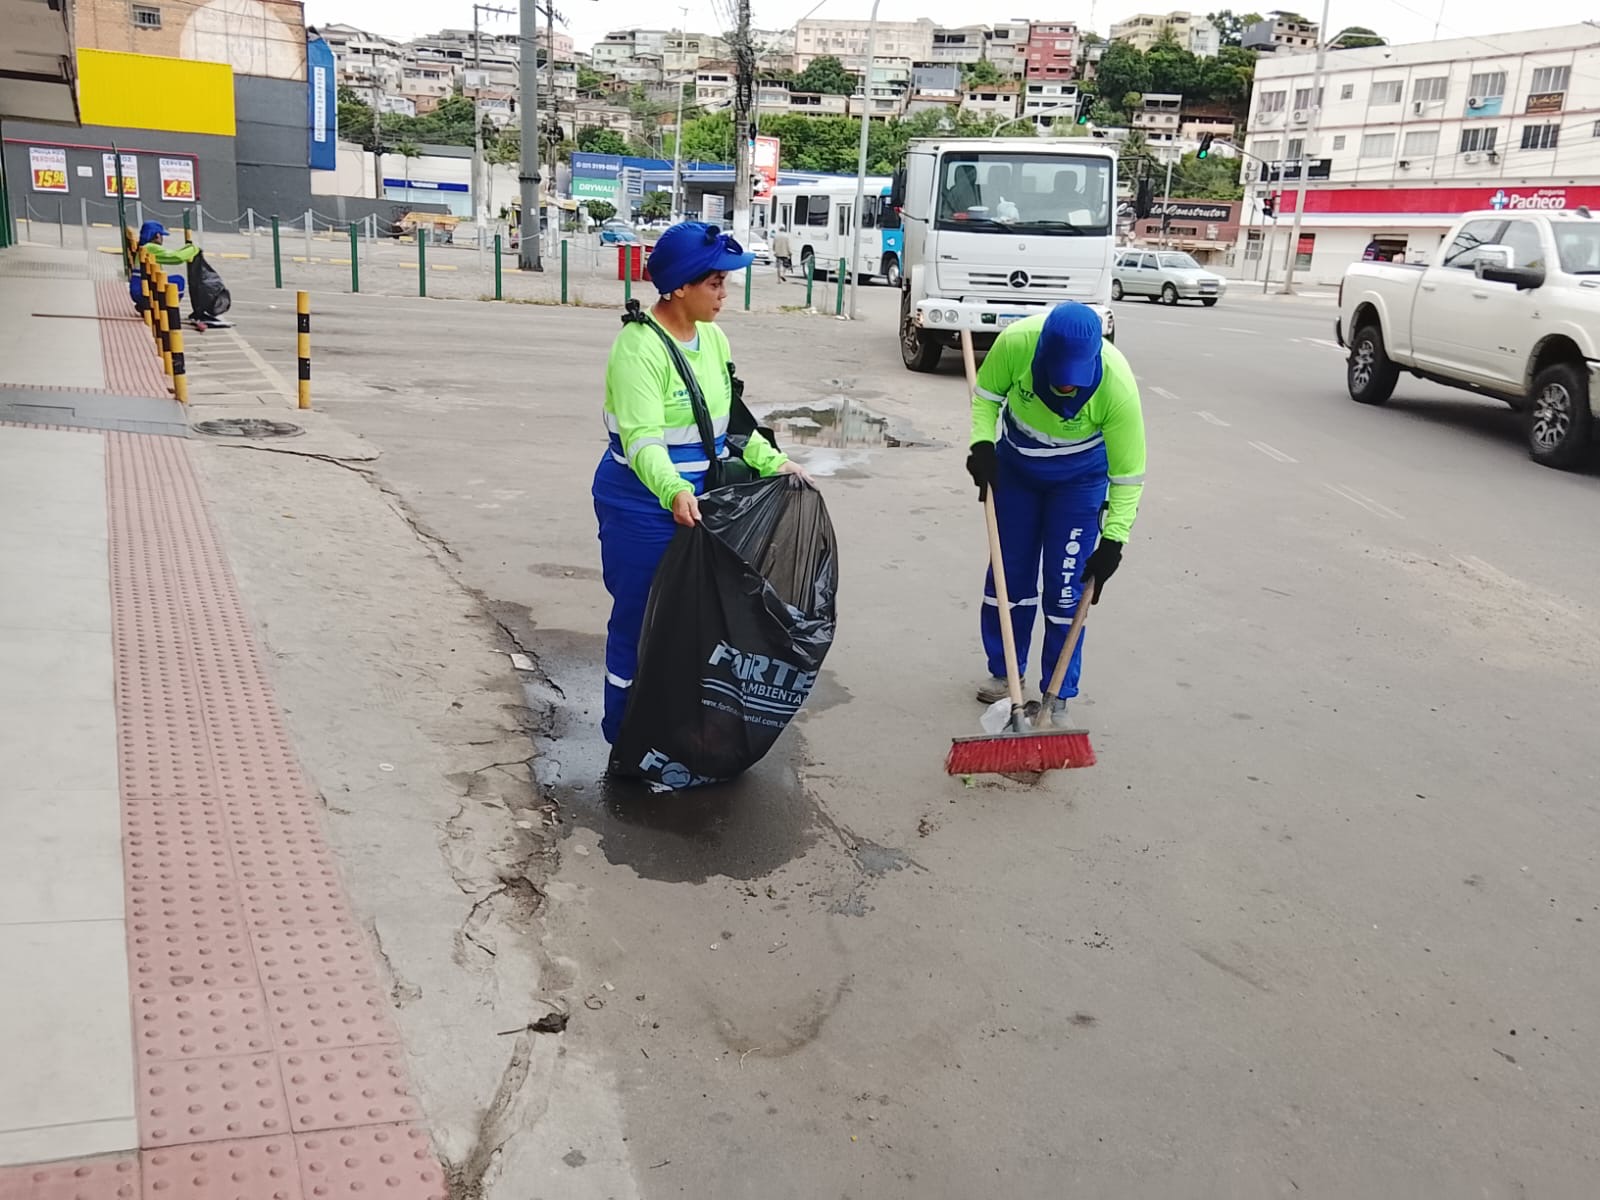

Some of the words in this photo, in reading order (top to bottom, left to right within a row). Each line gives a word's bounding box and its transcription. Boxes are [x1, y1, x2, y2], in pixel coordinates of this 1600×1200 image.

[1509, 193, 1566, 209] Pacheco
[1165, 205, 1227, 218] Construtor
[1061, 528, 1083, 598] FORTE
